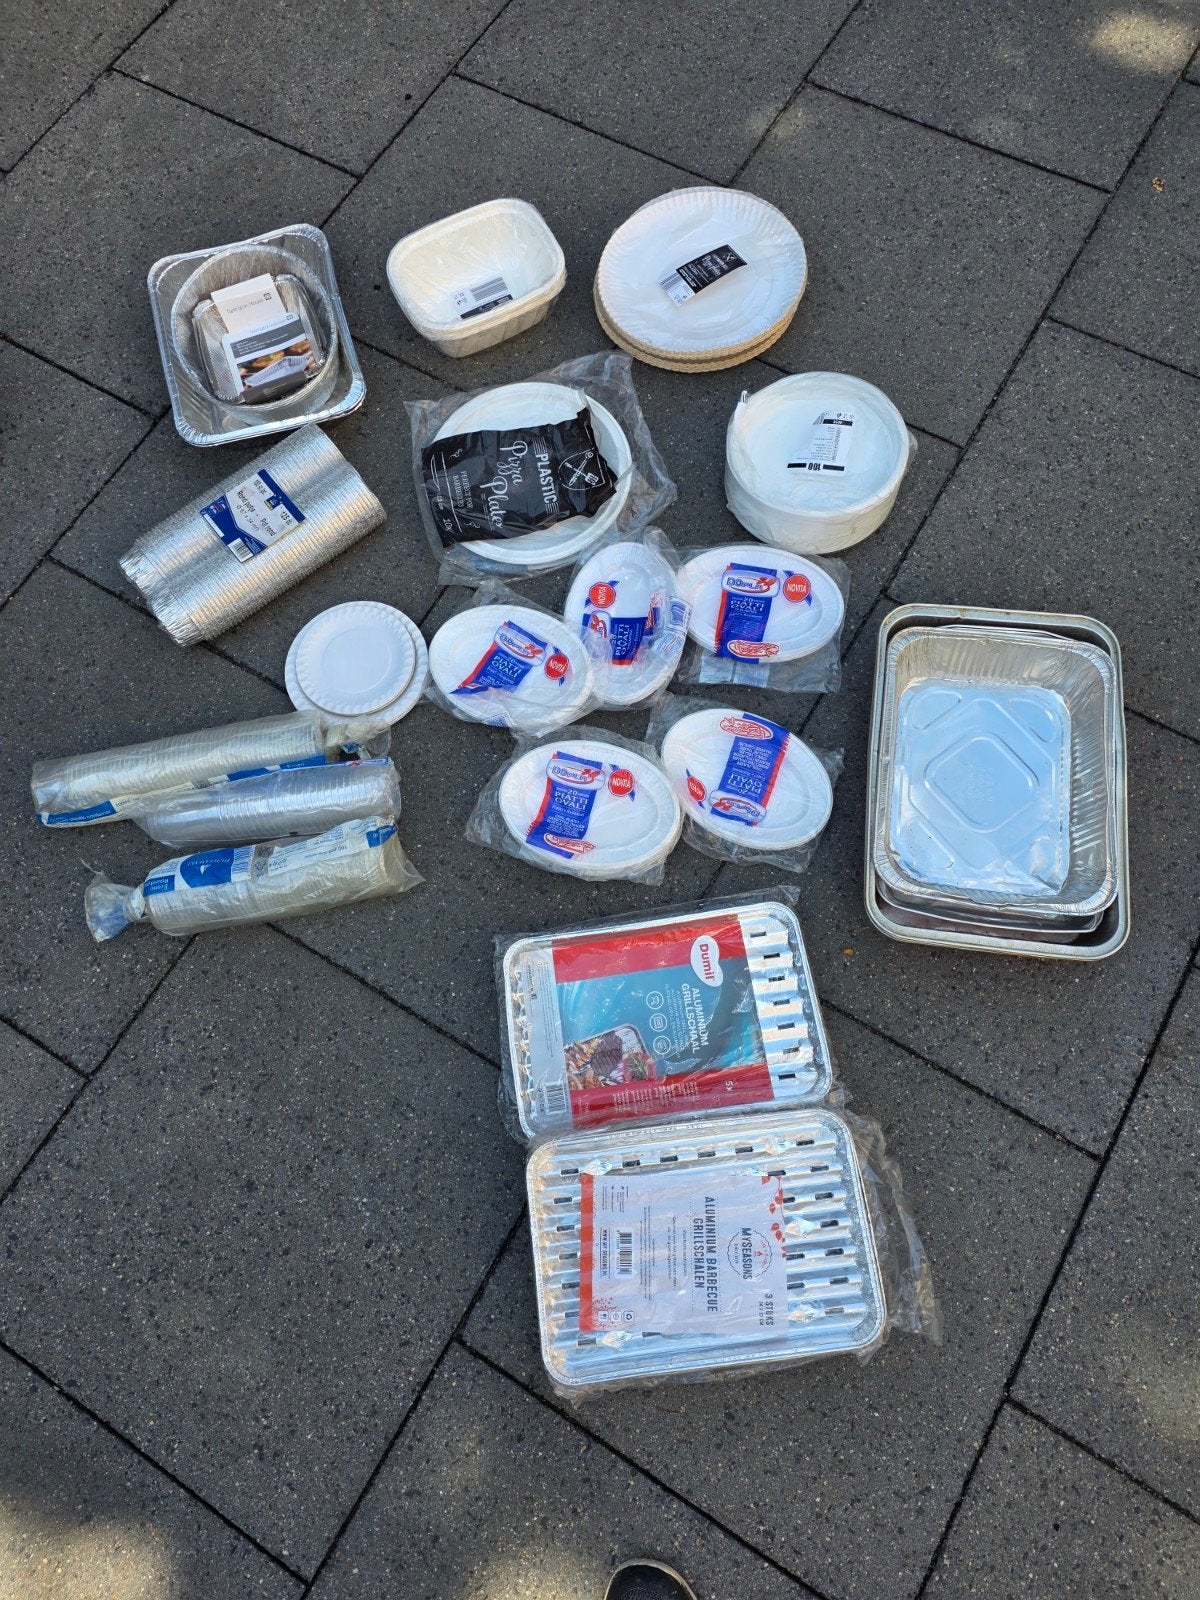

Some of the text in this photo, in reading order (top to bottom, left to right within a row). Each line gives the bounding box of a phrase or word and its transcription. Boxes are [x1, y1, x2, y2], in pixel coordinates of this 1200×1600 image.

[496, 440, 528, 487] Pizza
[534, 452, 557, 504] PLASTIC
[480, 475, 509, 529] Plates
[615, 623, 624, 655] PIATTI
[490, 660, 518, 678] OVALI
[492, 654, 522, 674] PIATTI
[727, 778, 761, 793] PIATTI
[729, 772, 762, 788] OVALI
[554, 791, 588, 804] PIATTI
[554, 798, 586, 810] OVALI
[699, 943, 714, 980] Dumil
[681, 983, 696, 1053] GRILLSCHAAL
[691, 987, 709, 1046] ALUMINIUM
[724, 1079, 734, 1092] 5x
[693, 1218, 705, 1288] GRILLSCHALEN
[704, 1196, 718, 1312] ALUMINIUM BARBECUE
[765, 1301, 773, 1325] STUKS
